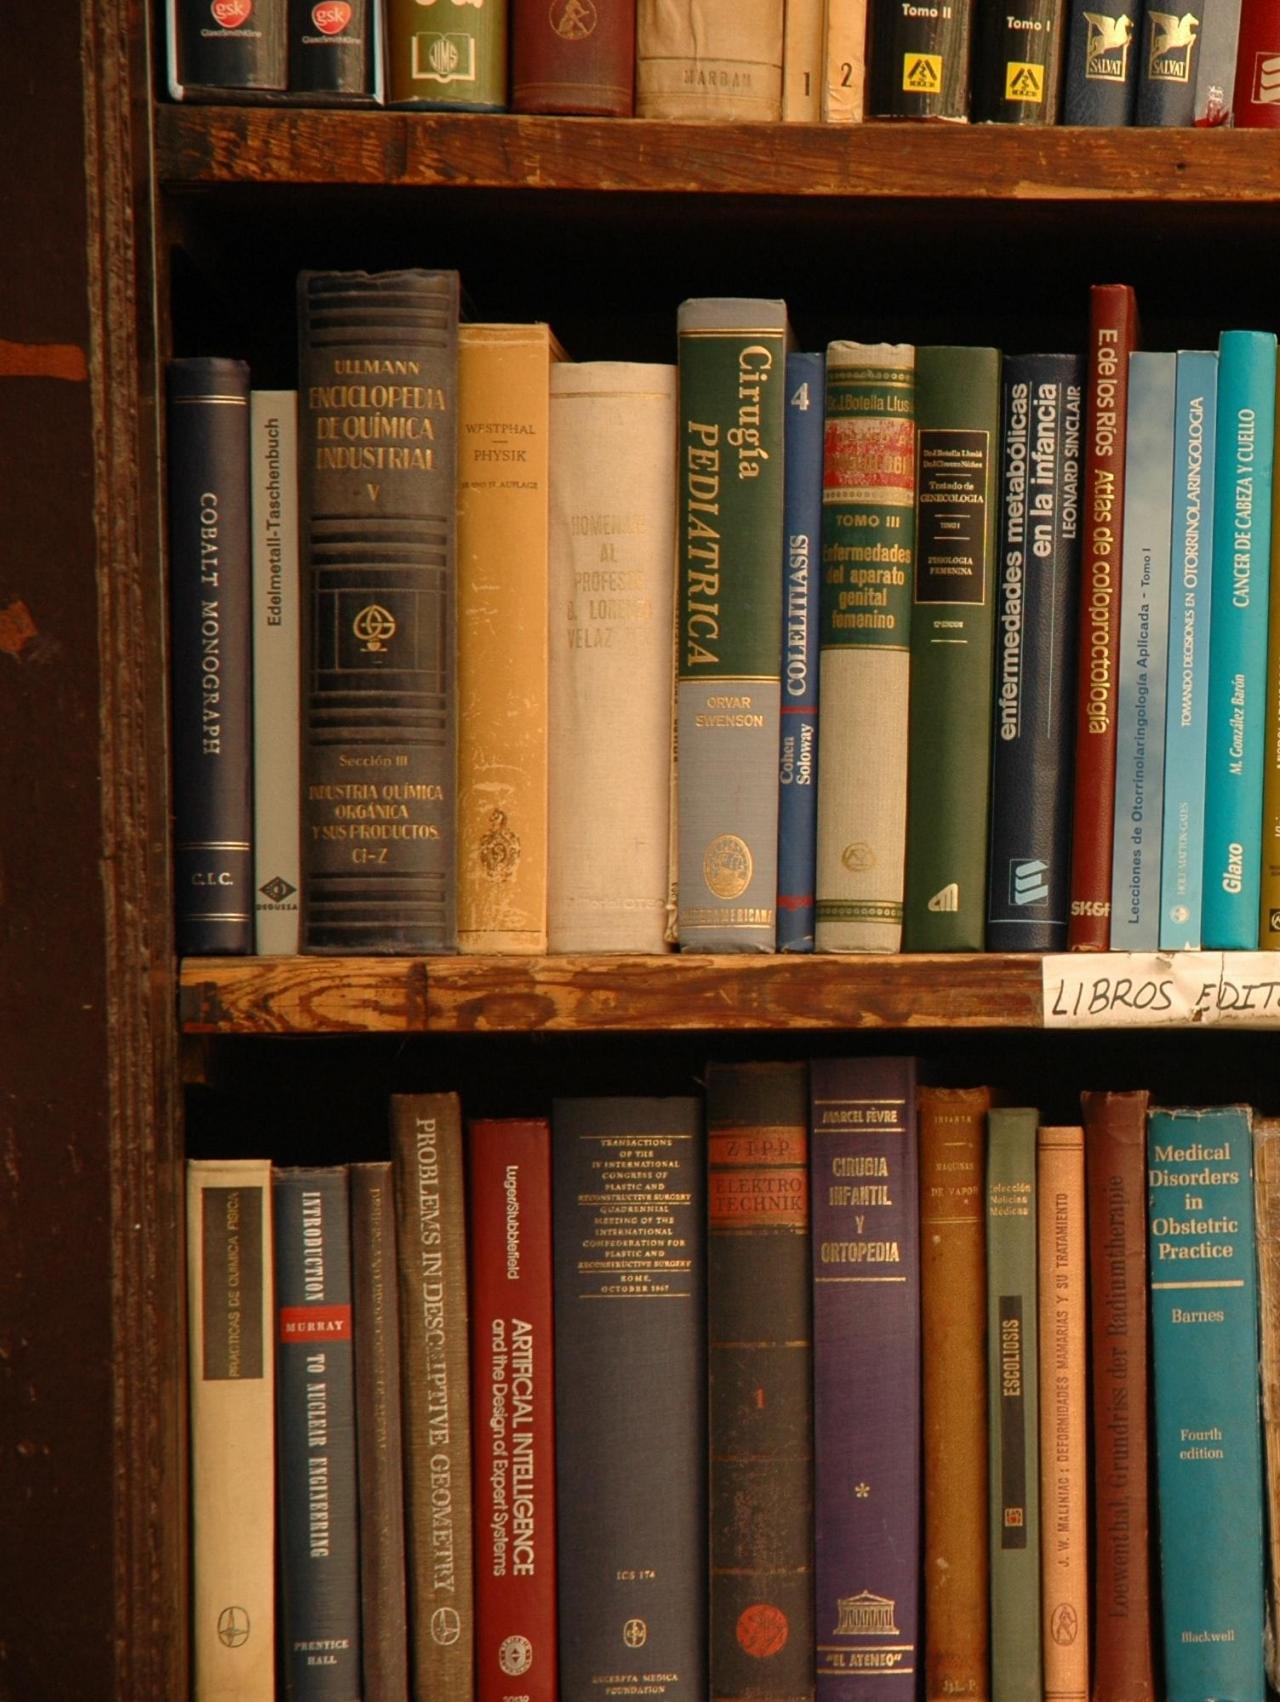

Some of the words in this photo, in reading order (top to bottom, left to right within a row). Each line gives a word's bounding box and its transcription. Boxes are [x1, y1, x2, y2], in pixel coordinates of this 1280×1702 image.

[902, 3, 937, 18] Tomo
[942, 4, 952, 19] II
[1006, 16, 1042, 32] Tomo
[803, 71, 812, 98] 1
[840, 62, 853, 89] 2
[1089, 59, 1124, 77] SALVAT
[1152, 59, 1187, 77] SALVAT
[334, 358, 421, 377] ULLMANN
[308, 384, 446, 412] ENCICLOPEDIA
[726, 345, 773, 480] Cirugía
[1065, 385, 1083, 456] SINCLAIR
[316, 416, 341, 440] DE
[342, 411, 435, 440] QUÍMICA
[1032, 382, 1057, 485] infancia
[1236, 408, 1256, 463] CUELLO
[316, 446, 435, 472] INDUSTRIAL
[473, 448, 528, 464] PHYSIK
[1005, 382, 1028, 544] metabólicas
[1031, 493, 1054, 516] la
[1062, 458, 1080, 539] LEONARD
[1093, 469, 1114, 523] Atlas
[1184, 396, 1204, 589] OTORRINOLARINGOLOGIA
[1233, 477, 1254, 529] CABEZA
[200, 491, 219, 587] COBALT
[265, 417, 282, 627] Edelmetall-Taschenbuch
[685, 420, 720, 669] PEDIATRICA
[836, 515, 880, 529] TOMO
[1034, 524, 1052, 557] en
[1091, 526, 1112, 555] de
[1233, 532, 1252, 551] DE
[838, 587, 888, 610] genital
[1232, 552, 1252, 608] CANCER
[787, 533, 811, 697] COLELITIASIS
[831, 611, 895, 630] femenino
[1135, 603, 1151, 668] Aplicada
[998, 550, 1022, 741] enfermedades
[1086, 559, 1112, 735] coloproctología
[201, 600, 221, 756] MONOGRAPH
[706, 696, 752, 710] ORVAR
[695, 714, 764, 729] SWENSON
[1131, 671, 1150, 822] Otorrinolaringología
[1230, 707, 1245, 758] González
[780, 735, 795, 785] Cohen
[796, 723, 814, 785] Soloway
[1127, 848, 1142, 924] Lecciones
[1221, 842, 1244, 895] Glaxo
[1051, 978, 1174, 1015] LIBROS
[832, 1157, 889, 1177] CIRUGIA
[1148, 1167, 1241, 1188] Disorders
[1153, 1142, 1232, 1163] Medical
[415, 1117, 440, 1246] PROBLEMS
[714, 1195, 803, 1213] TECHNIK
[715, 1177, 801, 1195] ELEKTRO
[828, 1184, 893, 1207] INFANTIL
[1184, 1193, 1205, 1212] in
[301, 1191, 325, 1302] INTRODUCTION
[504, 1165, 520, 1280] Luger/Stubblefield
[1055, 1193, 1069, 1269] TRATAMIENTO
[1151, 1216, 1239, 1237] Obstetric
[421, 1252, 443, 1277] IN
[820, 1242, 900, 1263] ORTOPEDIA
[1108, 1174, 1128, 1337] Radiumtherapie
[1157, 1241, 1234, 1262] Practice
[284, 1318, 345, 1332] MURRAY
[492, 1318, 508, 1350] and
[1056, 1310, 1070, 1370] MAMARIAS
[1171, 1307, 1226, 1325] Barnes
[492, 1353, 508, 1380] the
[511, 1318, 535, 1428] ARTIFICIAL
[1002, 1319, 1022, 1397] ESCOLIOSIS
[307, 1382, 328, 1447] NUCLEAR
[489, 1383, 509, 1438] Design
[1056, 1376, 1071, 1463] DEFORMIDADES
[1179, 1427, 1223, 1443] Fourth
[1110, 1384, 1130, 1488] Grundriss
[1179, 1448, 1224, 1461] edition
[308, 1456, 331, 1558] ENGINEERING
[489, 1459, 509, 1509] Expert
[511, 1432, 536, 1576] INTELLIGENCE
[428, 1453, 455, 1593] GEOMETRY
[489, 1511, 509, 1576] Systems
[293, 1638, 350, 1653] PRENTICE
[1181, 1629, 1237, 1644] Blackwell
